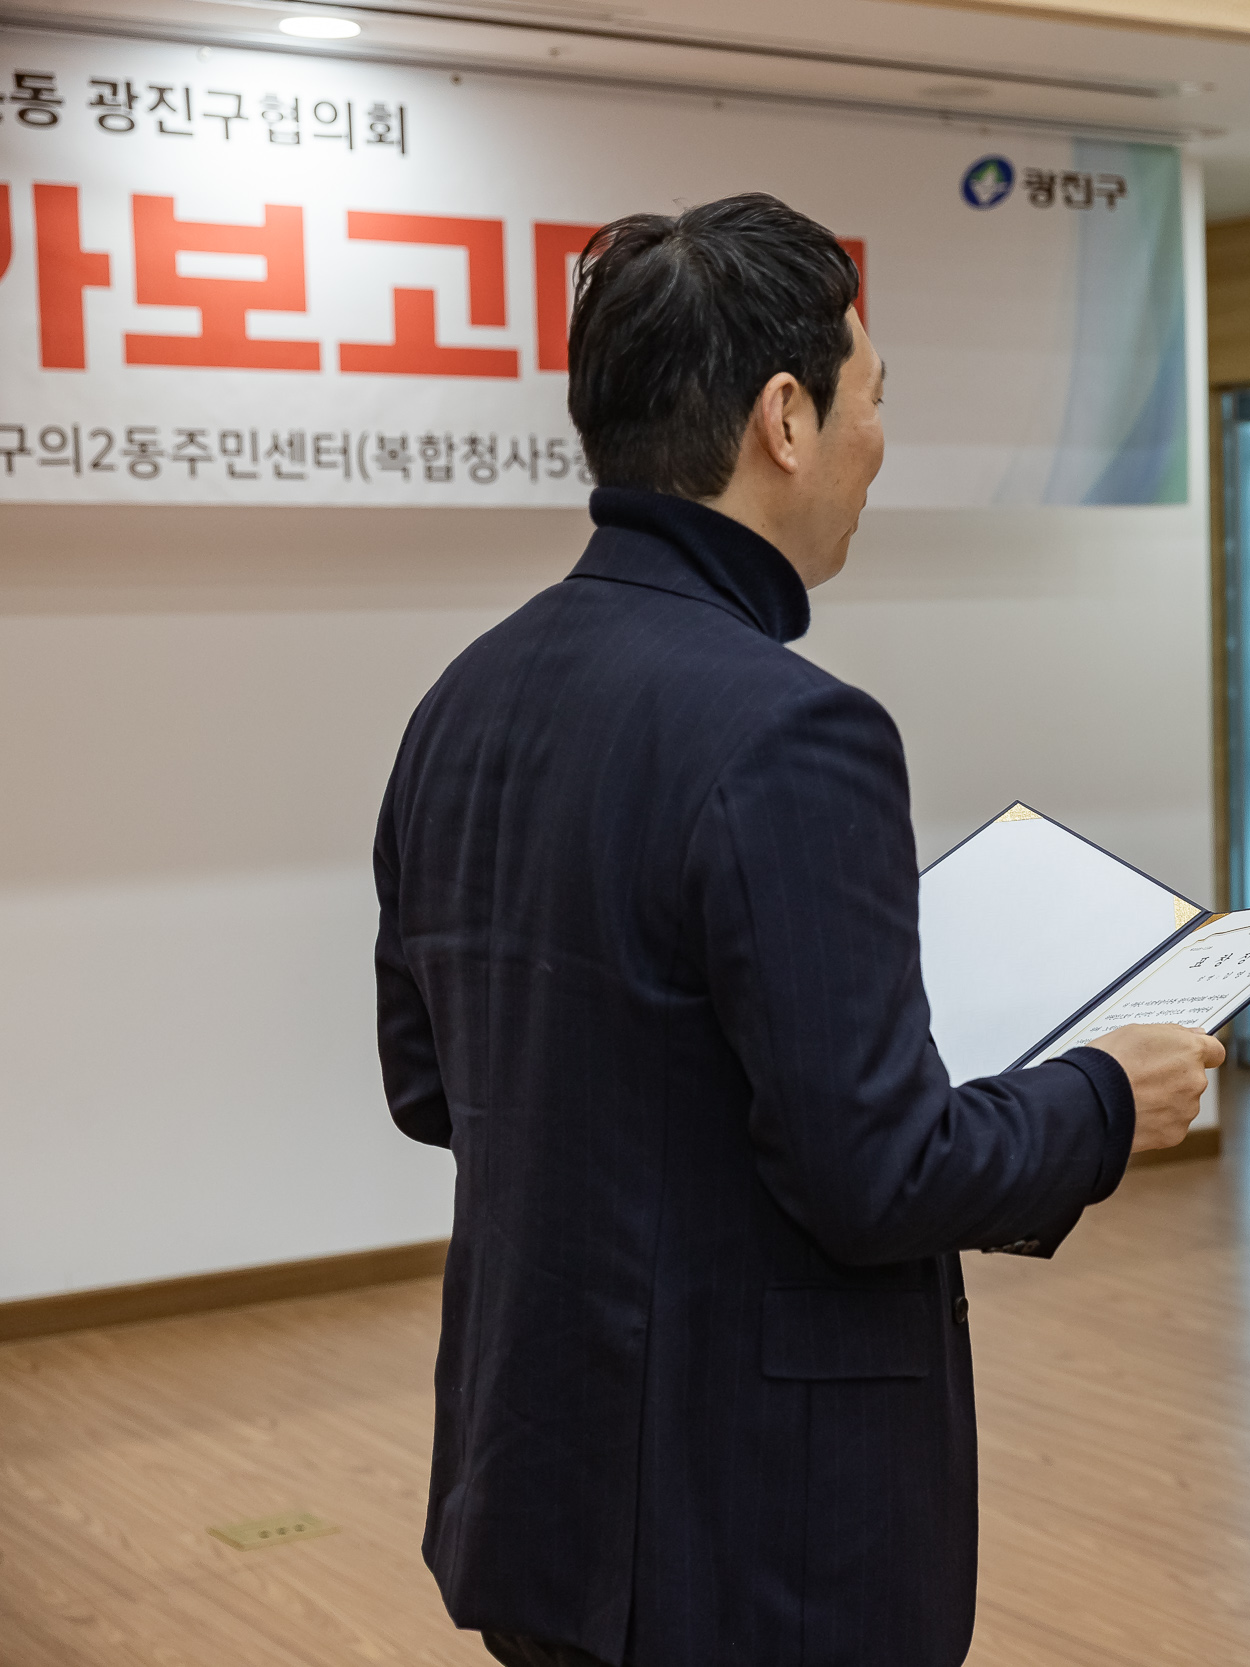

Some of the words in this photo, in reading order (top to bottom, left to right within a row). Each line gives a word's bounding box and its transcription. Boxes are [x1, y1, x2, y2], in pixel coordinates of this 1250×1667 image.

[0, 69, 63, 127] 동
[88, 78, 408, 157] 광진구협의회
[1023, 166, 1128, 212] 광진구
[0, 180, 867, 381] 가보고
